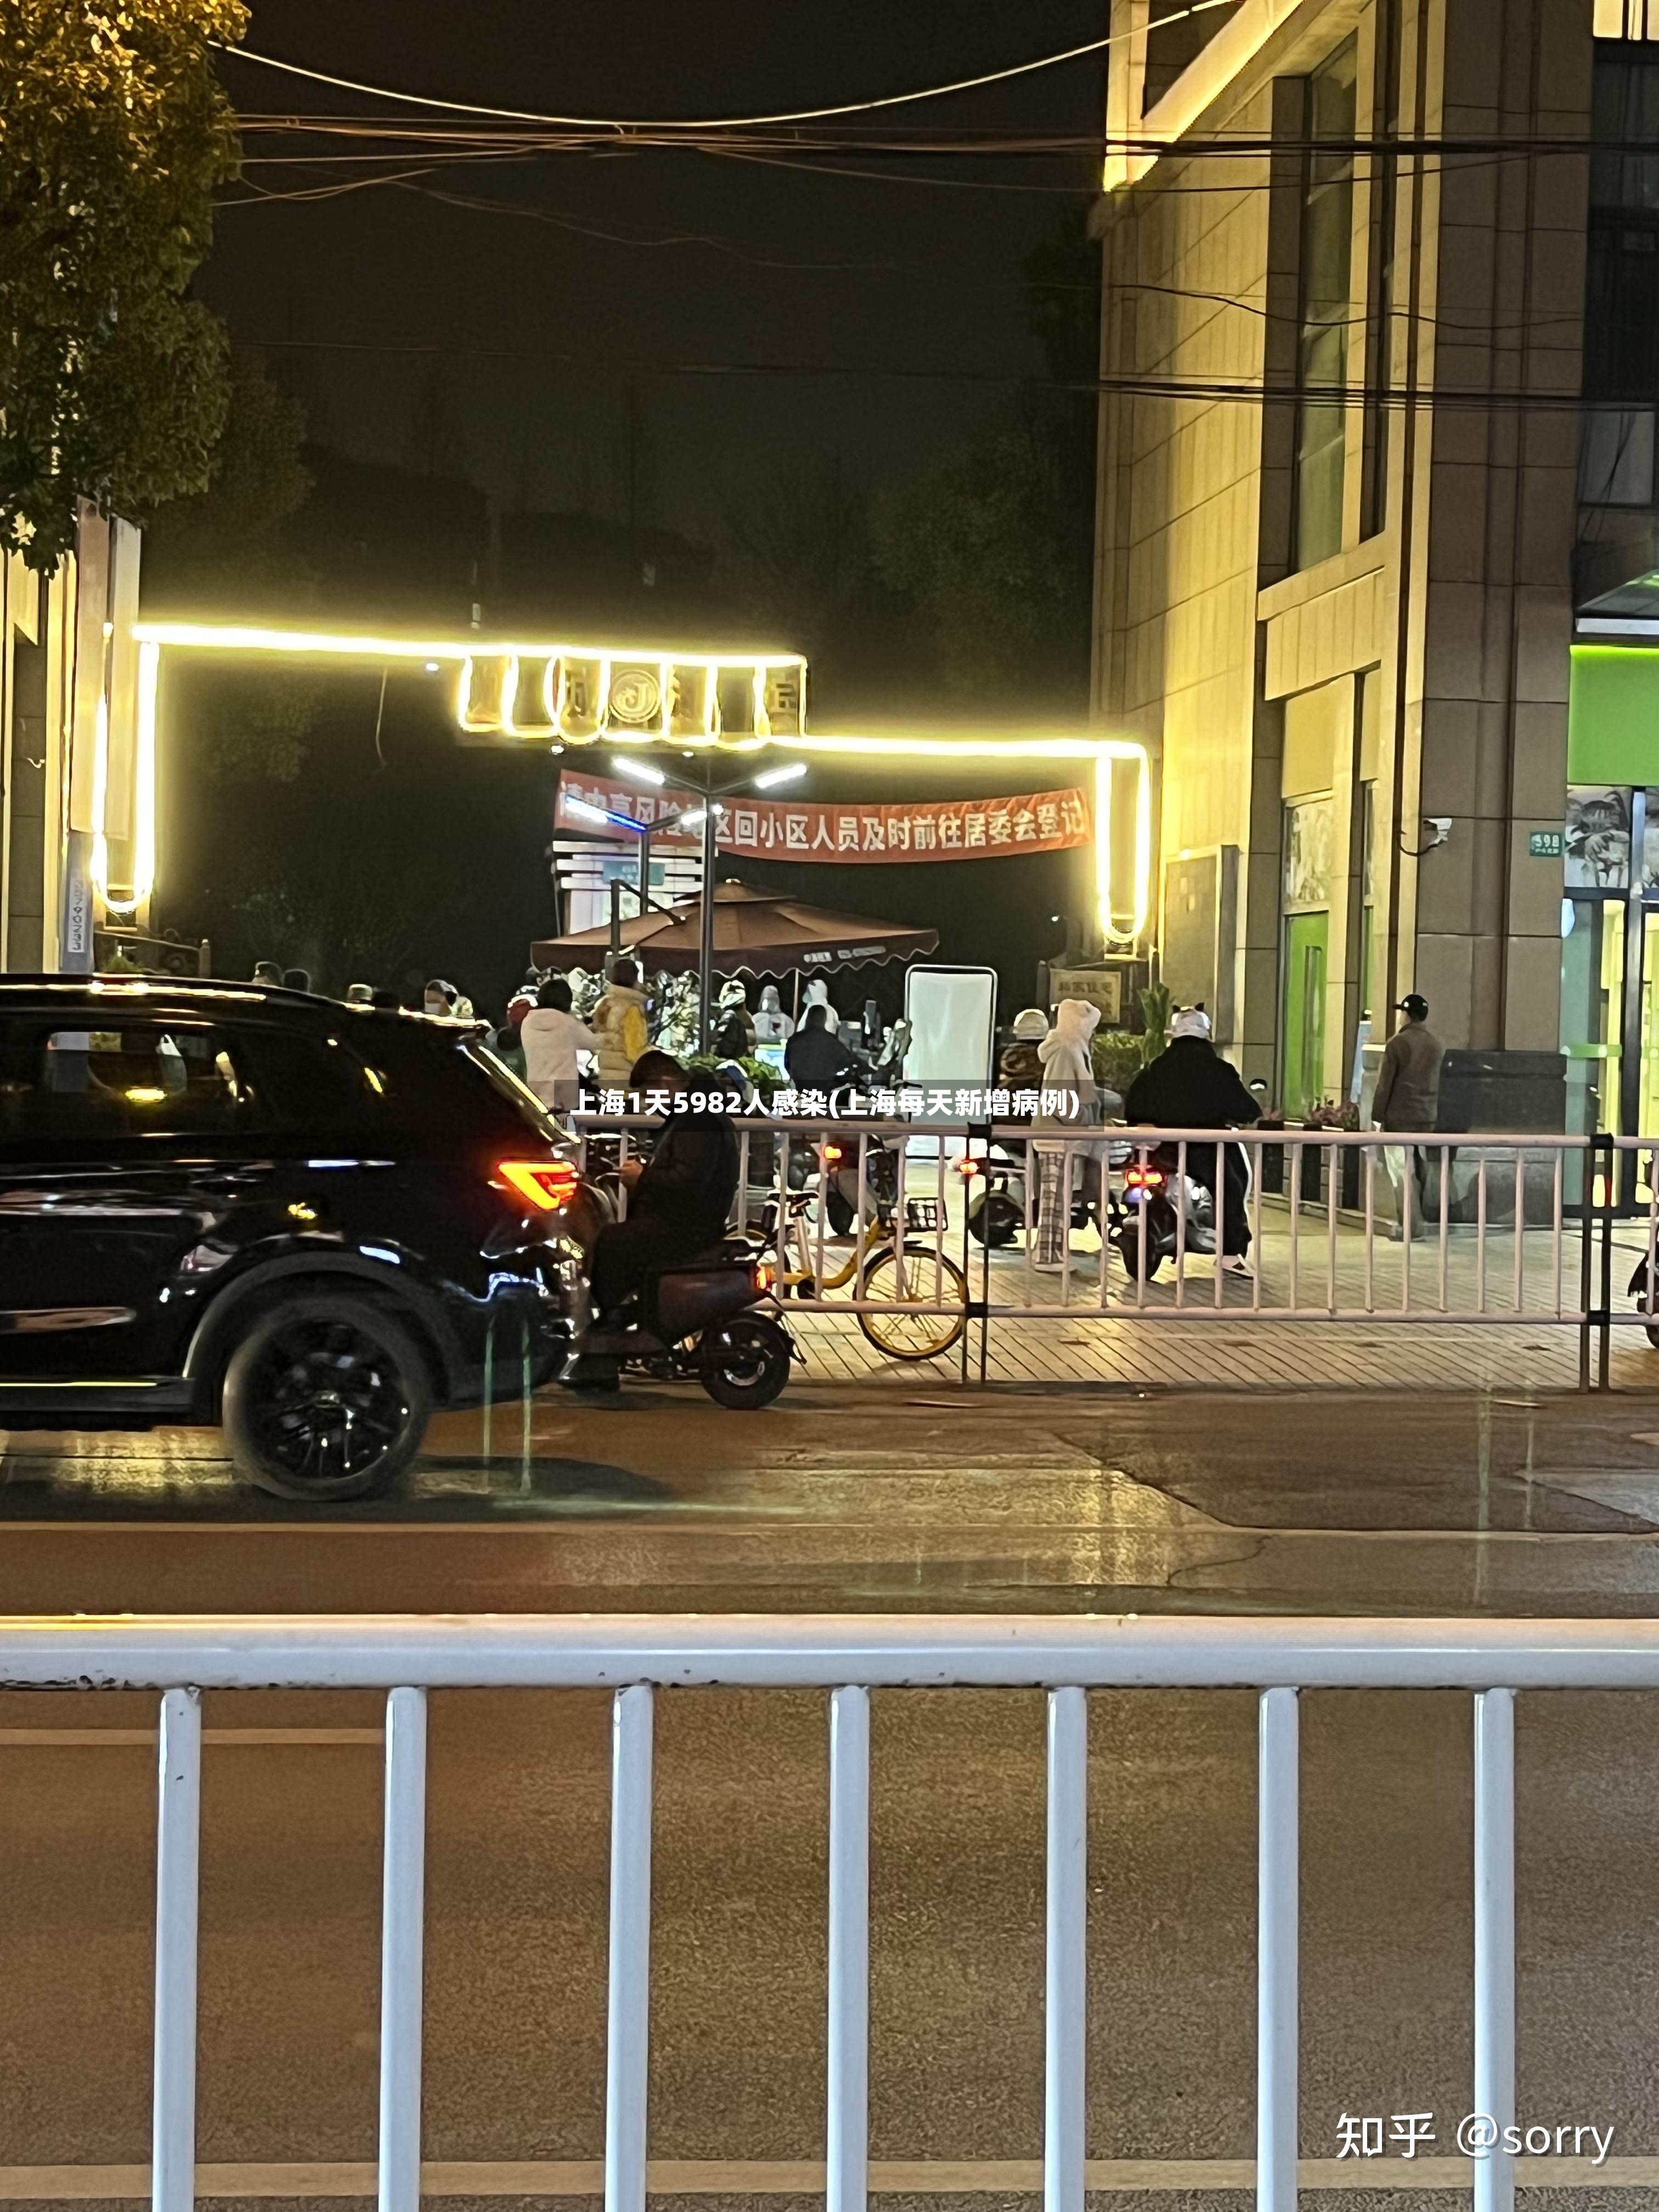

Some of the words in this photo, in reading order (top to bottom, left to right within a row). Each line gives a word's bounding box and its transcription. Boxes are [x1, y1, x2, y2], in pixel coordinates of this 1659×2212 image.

[560, 781, 1085, 851] 请中高风险区回小区人员及时前往居委会登记
